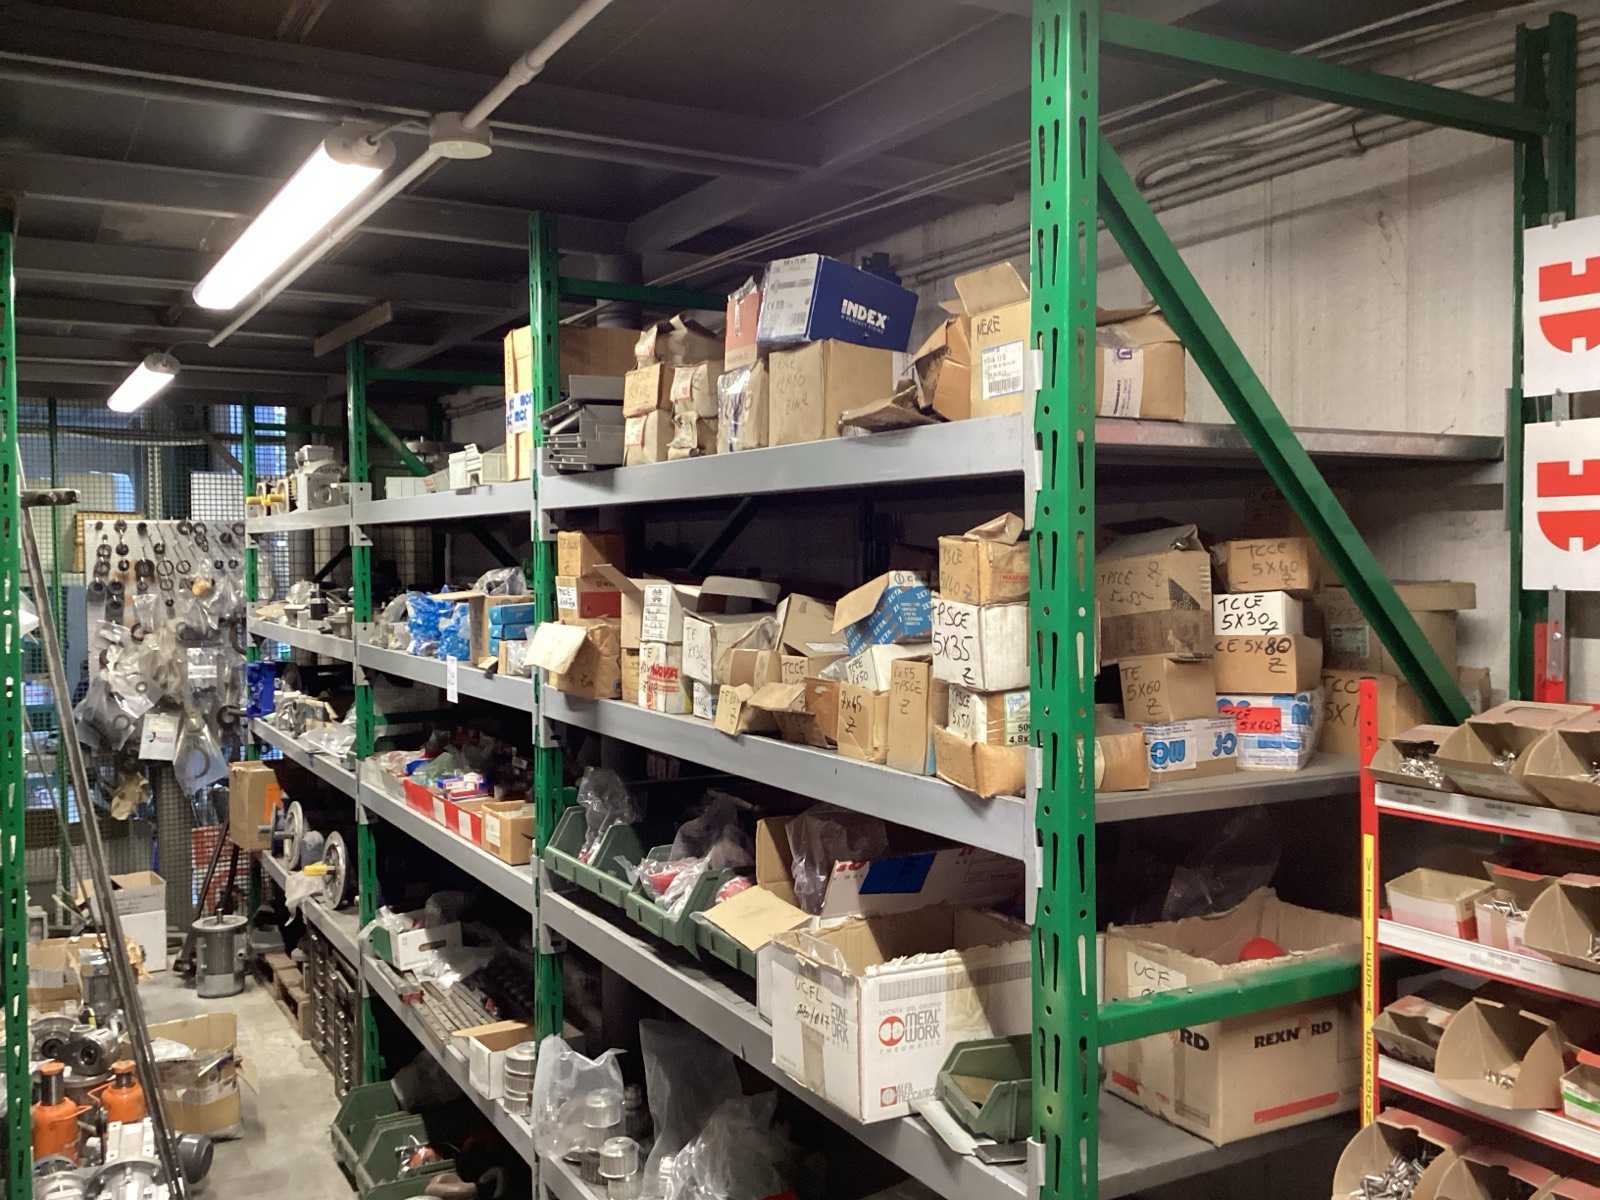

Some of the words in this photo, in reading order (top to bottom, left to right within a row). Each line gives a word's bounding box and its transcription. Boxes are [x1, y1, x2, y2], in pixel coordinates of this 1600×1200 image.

[840, 298, 888, 329] INDEX
[1217, 594, 1265, 612] TCCE
[1221, 611, 1270, 630] 5X30
[905, 1009, 940, 1027] METAL
[905, 1024, 940, 1042] WORK
